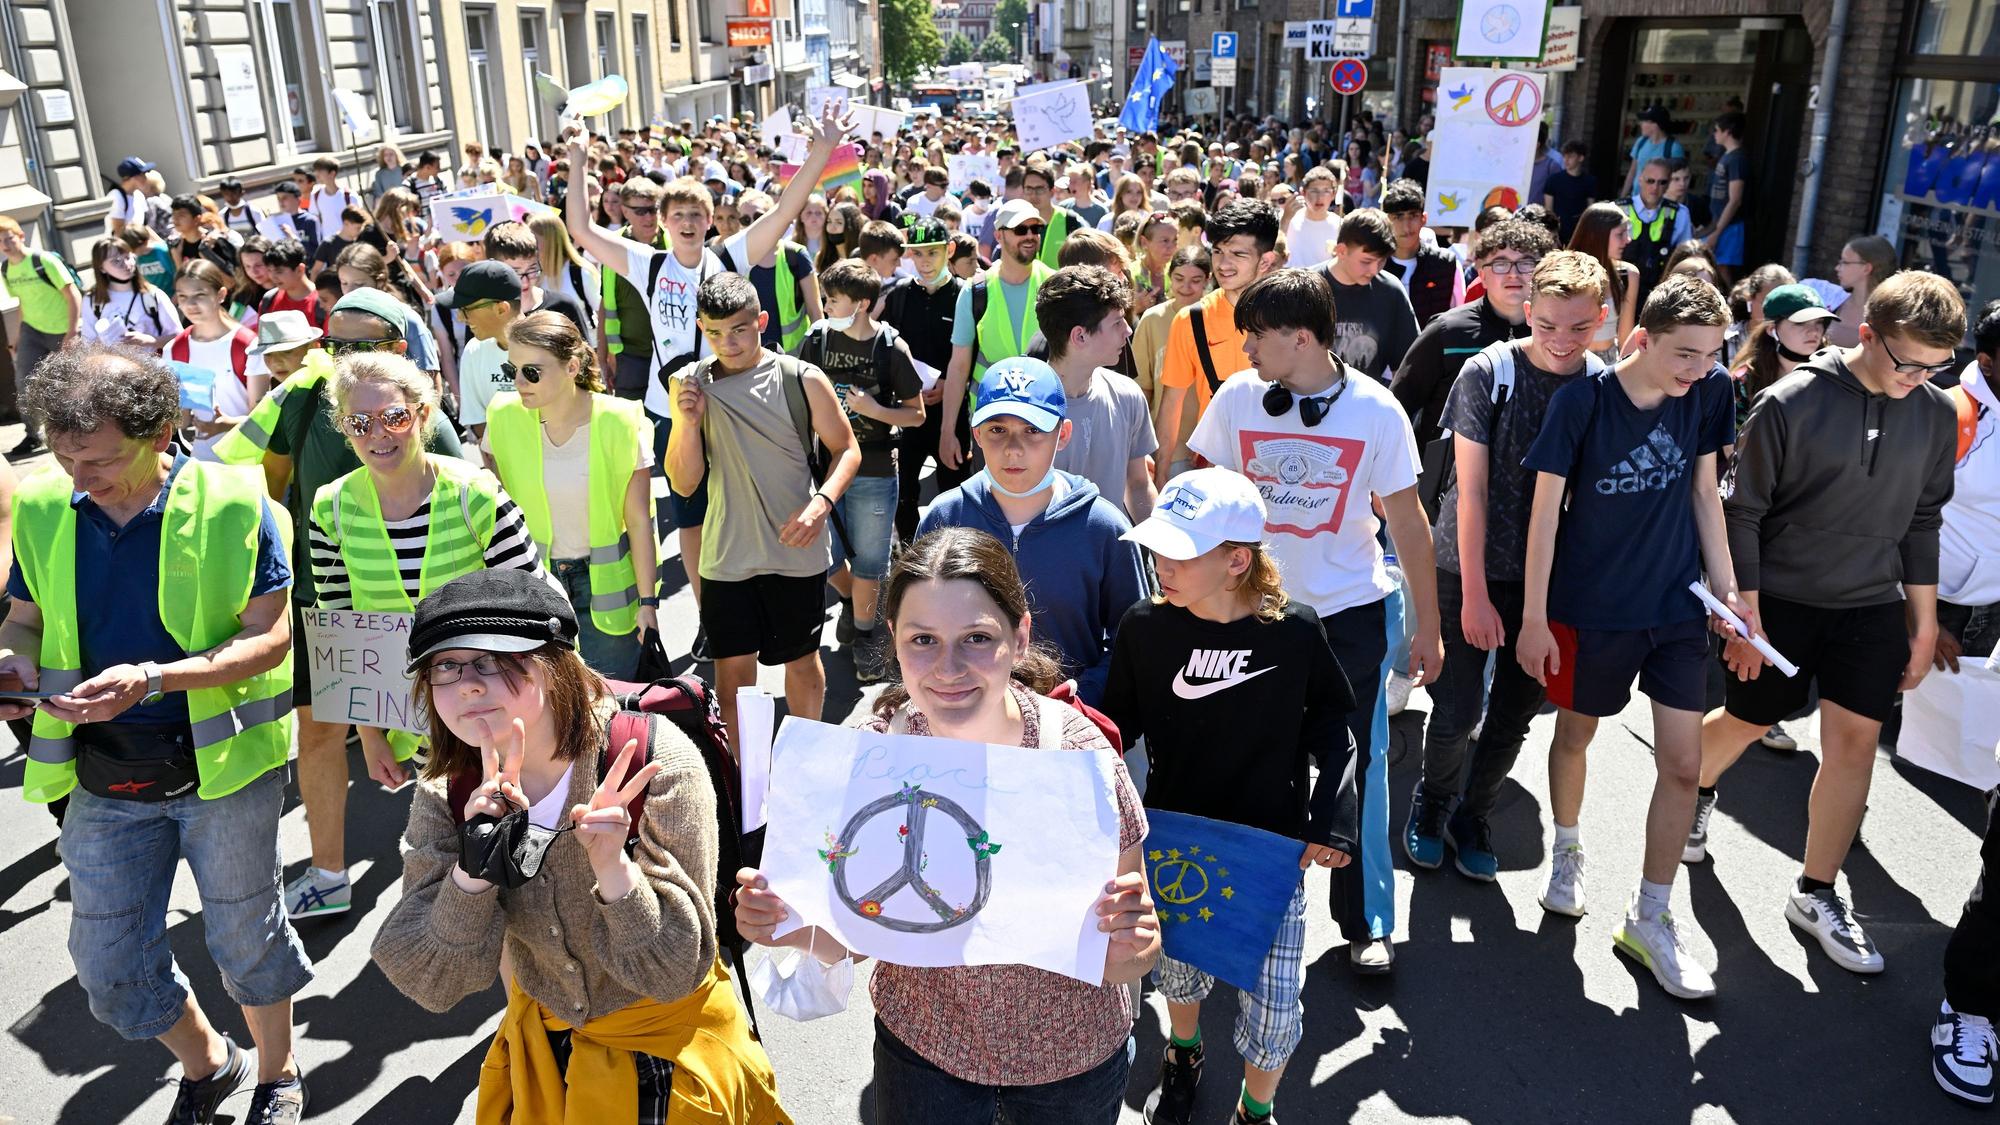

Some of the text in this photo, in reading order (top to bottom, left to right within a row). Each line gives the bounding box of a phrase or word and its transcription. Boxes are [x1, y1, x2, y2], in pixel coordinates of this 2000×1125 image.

[730, 27, 769, 40] SHOP
[1312, 24, 1332, 36] My
[1217, 36, 1231, 55] P
[659, 277, 687, 295] CITY
[659, 299, 688, 318] CITY
[996, 367, 1036, 397] NY
[1260, 485, 1330, 509] Budweiser
[304, 611, 345, 629] MER
[315, 646, 382, 675] MER
[1185, 648, 1253, 680] NIKE
[850, 745, 1021, 794] Peace
